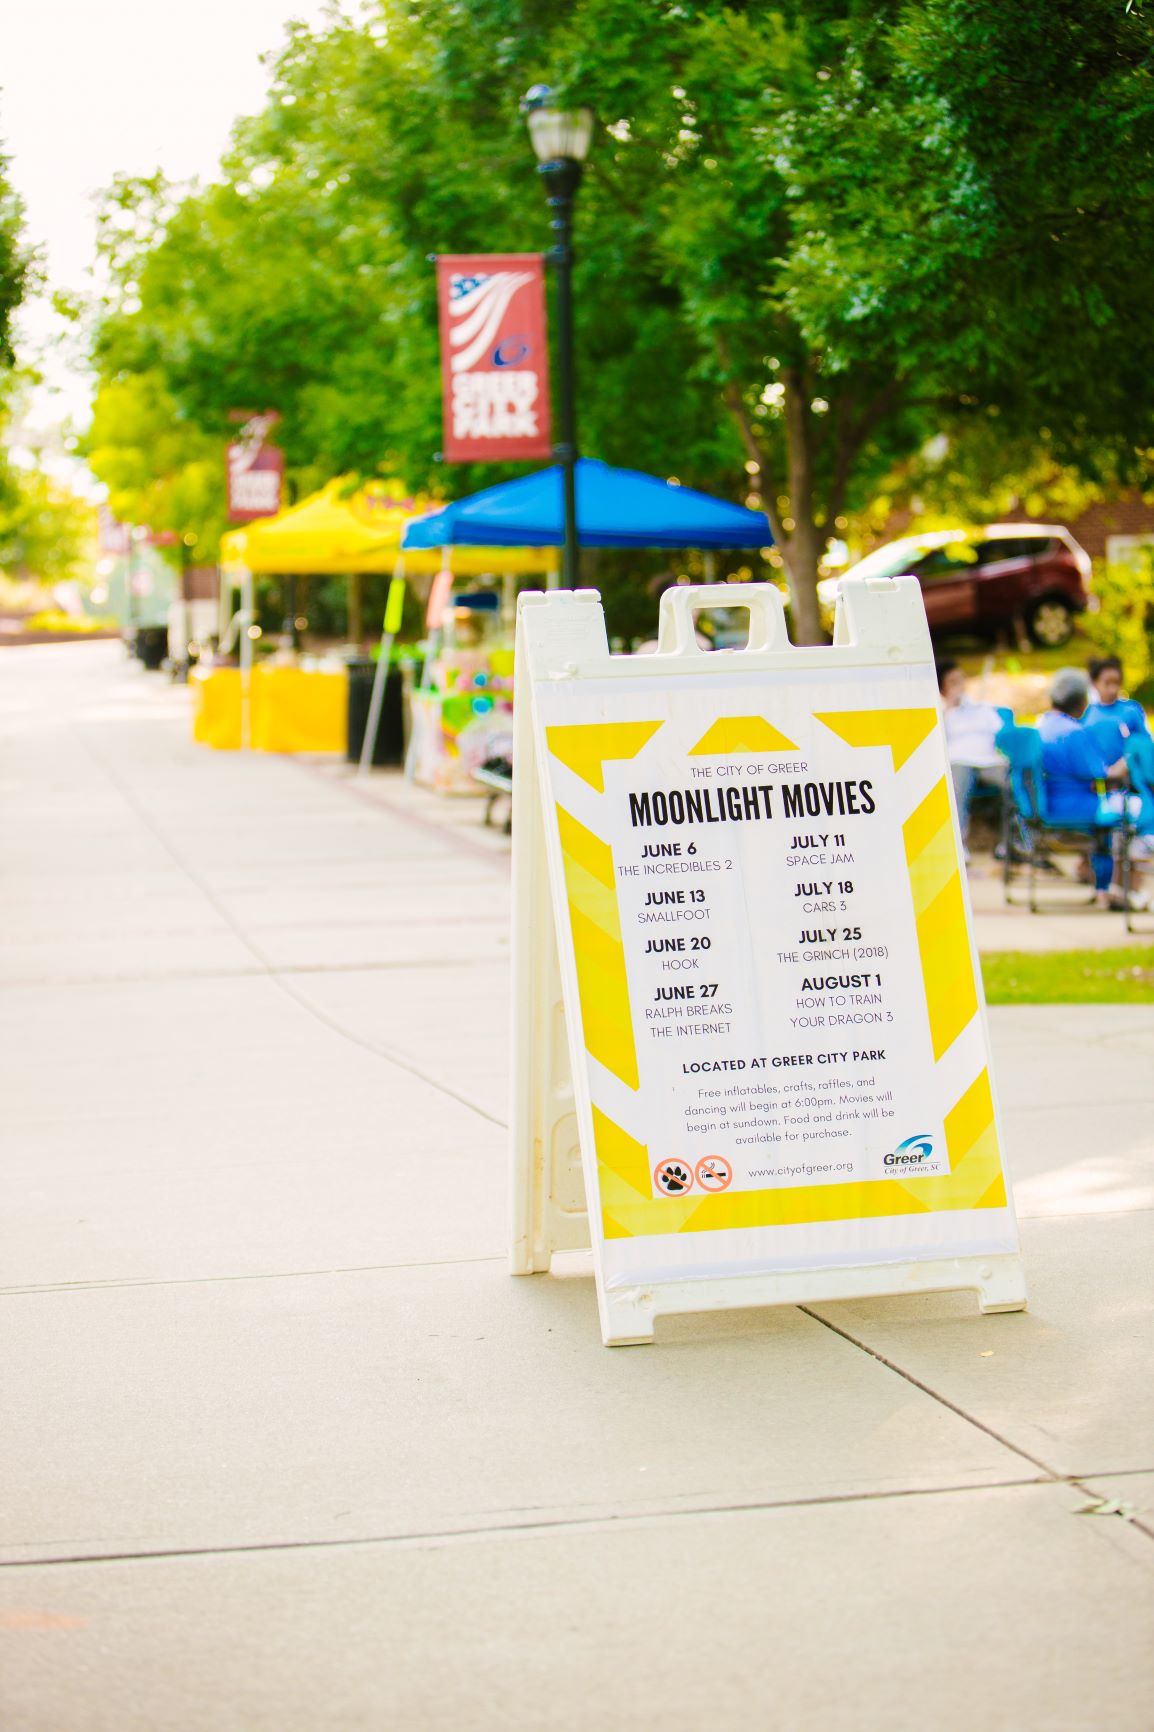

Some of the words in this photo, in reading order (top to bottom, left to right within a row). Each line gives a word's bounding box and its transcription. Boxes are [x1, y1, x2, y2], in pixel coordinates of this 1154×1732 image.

[452, 397, 537, 419] CITY
[453, 416, 540, 438] PARK
[691, 767, 711, 778] THE
[717, 766, 742, 776] CITY
[747, 765, 764, 775] OF
[768, 762, 808, 773] GREER
[629, 785, 773, 827] MOONLIGHT
[782, 780, 875, 818] MOVIES
[791, 835, 829, 849] JULY
[834, 834, 845, 846] 11
[642, 843, 682, 858] JUNE
[687, 842, 696, 855] 6
[787, 854, 826, 866] SPACE
[831, 853, 854, 864] JAM
[618, 866, 640, 876] THE
[644, 861, 721, 875] INCREDIBLES
[725, 860, 732, 869] 2
[795, 882, 833, 896] JULY
[838, 881, 853, 894] 18
[645, 891, 685, 905] JUNE
[690, 890, 705, 902] 13
[803, 902, 836, 913] CARS
[840, 901, 846, 911] 3
[638, 909, 710, 923] SMALLFOOT
[799, 929, 837, 943] JULY
[843, 927, 861, 940] 25
[645, 938, 685, 953] JUNE
[690, 937, 711, 950] 20
[777, 952, 799, 963] THE
[803, 949, 849, 961] GRINCH
[854, 946, 888, 961] (2018)
[663, 959, 699, 970] HOOK
[802, 974, 871, 991] AUGUST
[876, 974, 881, 986] 1
[654, 986, 695, 1001] JUNE
[700, 984, 718, 998] 27
[797, 998, 825, 1008] HOW
[828, 996, 846, 1006] TO
[849, 994, 882, 1005] TRAIN
[646, 1007, 682, 1019] RALPH
[687, 1004, 732, 1016] BREAKS
[790, 1016, 825, 1027] YOUR
[829, 1013, 882, 1026] DRAGON
[886, 1012, 893, 1021] 3
[650, 1027, 672, 1037] THE
[677, 1023, 730, 1036] INTERNET
[683, 1060, 745, 1073] LOCATED
[751, 1058, 767, 1068] AT
[772, 1055, 813, 1067] GREER
[817, 1052, 848, 1064] CITY
[853, 1050, 886, 1061] PARK
[698, 1089, 721, 1098] Free
[725, 1084, 780, 1096] inflatables,
[784, 1081, 815, 1092] crafts,
[819, 1079, 853, 1089] raffles,
[857, 1077, 875, 1086] and
[685, 1103, 727, 1115] dancing
[730, 1102, 746, 1112] will
[749, 1101, 777, 1112] begin
[781, 1100, 791, 1108] at
[795, 1097, 835, 1108] 6:00pm.
[839, 1095, 873, 1104] Movies
[876, 1091, 892, 1101] will
[686, 1121, 716, 1133] begin
[720, 1121, 730, 1129] at
[733, 1117, 780, 1128] sundown.
[784, 1114, 809, 1124] Food
[813, 1112, 832, 1122] and
[836, 1109, 860, 1120] drink
[863, 1109, 878, 1118] will
[881, 1108, 894, 1117] be
[736, 1132, 781, 1144] available
[785, 1131, 799, 1140] for
[803, 1128, 852, 1142] purchase.
[883, 1154, 924, 1165] Greer
[748, 1163, 853, 1177] www.cityofgreer.org
